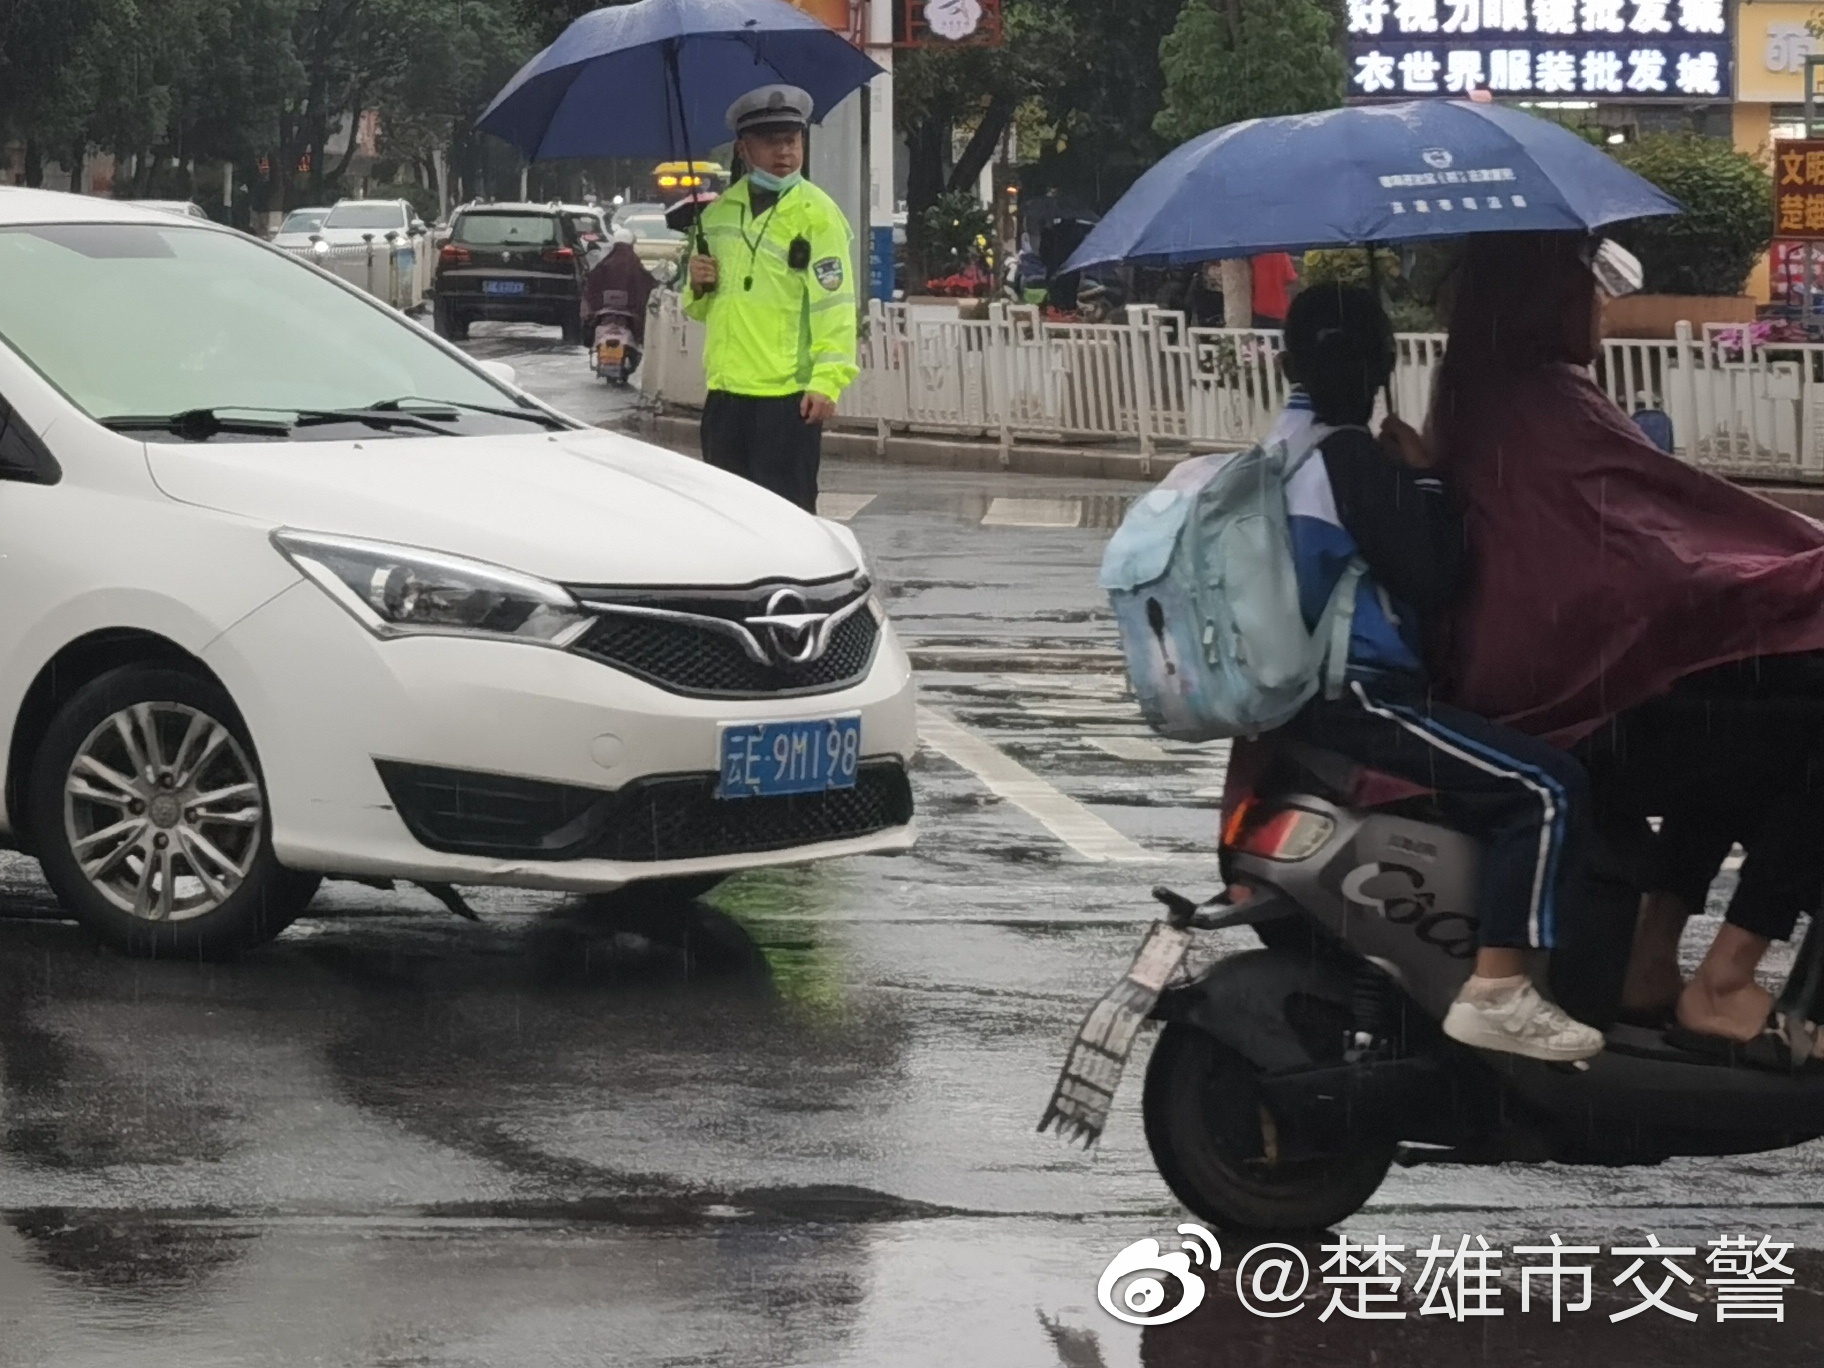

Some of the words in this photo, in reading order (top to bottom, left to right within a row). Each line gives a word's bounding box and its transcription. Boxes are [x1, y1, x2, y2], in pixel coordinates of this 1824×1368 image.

[1353, 49, 1720, 94] 衣世界服装批发城
